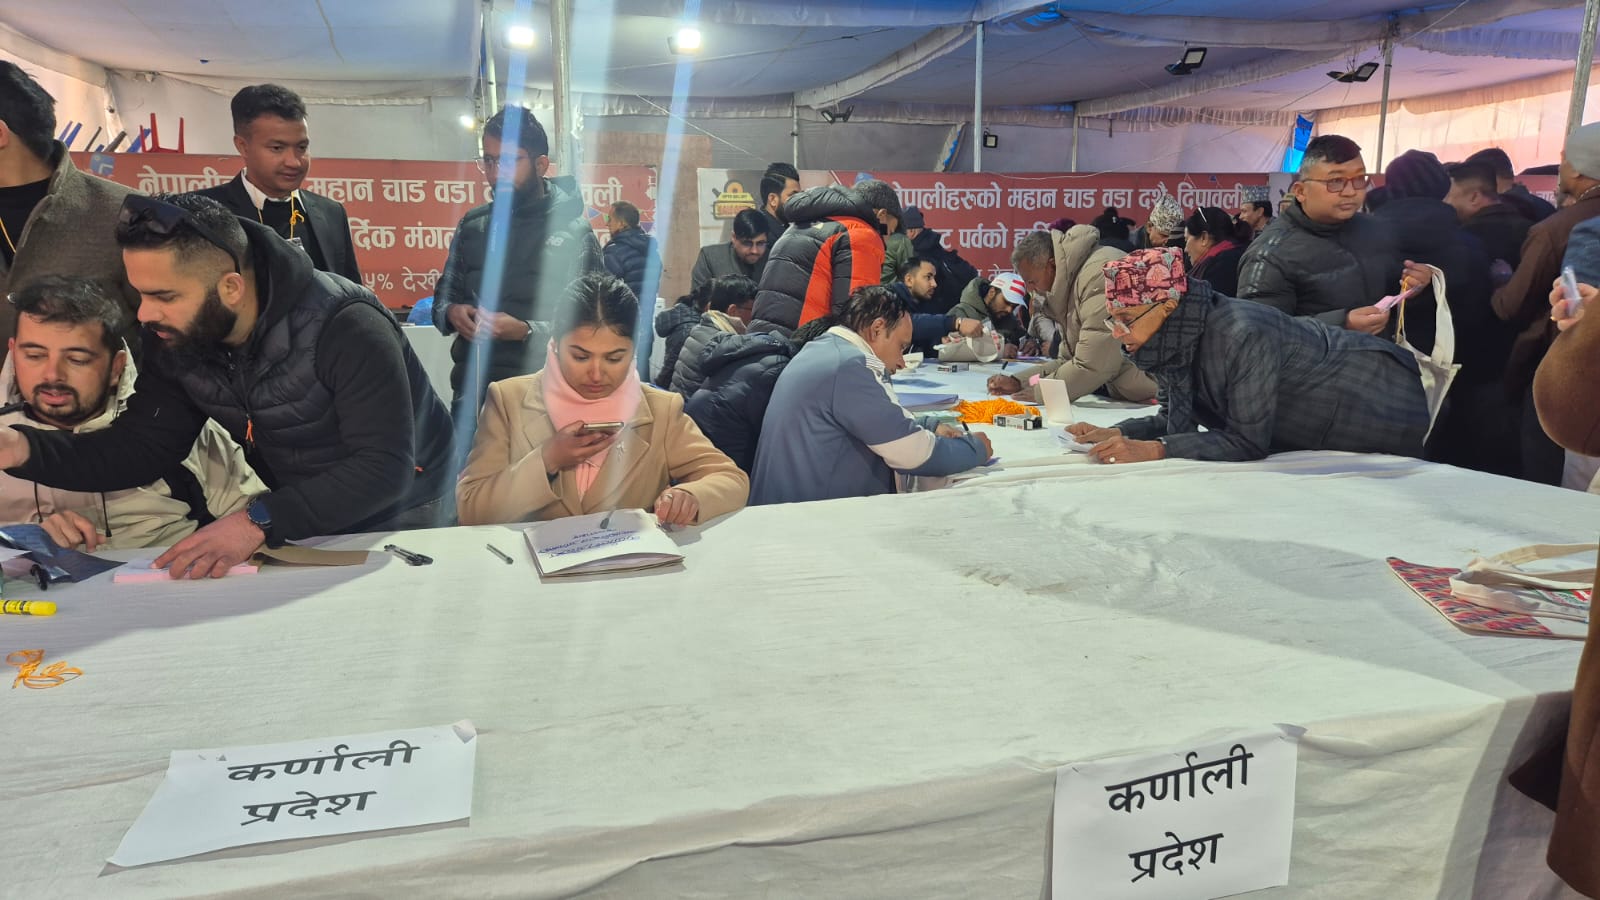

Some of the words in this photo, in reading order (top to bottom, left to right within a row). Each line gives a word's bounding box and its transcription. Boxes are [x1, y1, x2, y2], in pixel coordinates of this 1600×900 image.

[136, 164, 236, 197] नेपाली
[381, 179, 427, 203] चाड
[434, 180, 475, 204] वडा
[580, 176, 623, 207] वली
[1007, 188, 1058, 210] महान
[1063, 188, 1098, 209] चाड
[1102, 188, 1134, 209] वडा
[350, 216, 397, 249] र्दिक
[958, 222, 1008, 249] पर्वको
[227, 739, 421, 782] कर्णाली
[1104, 743, 1254, 813] कर्णाली
[240, 791, 377, 826] प्रदेश
[1128, 831, 1224, 883] प्रदेश
